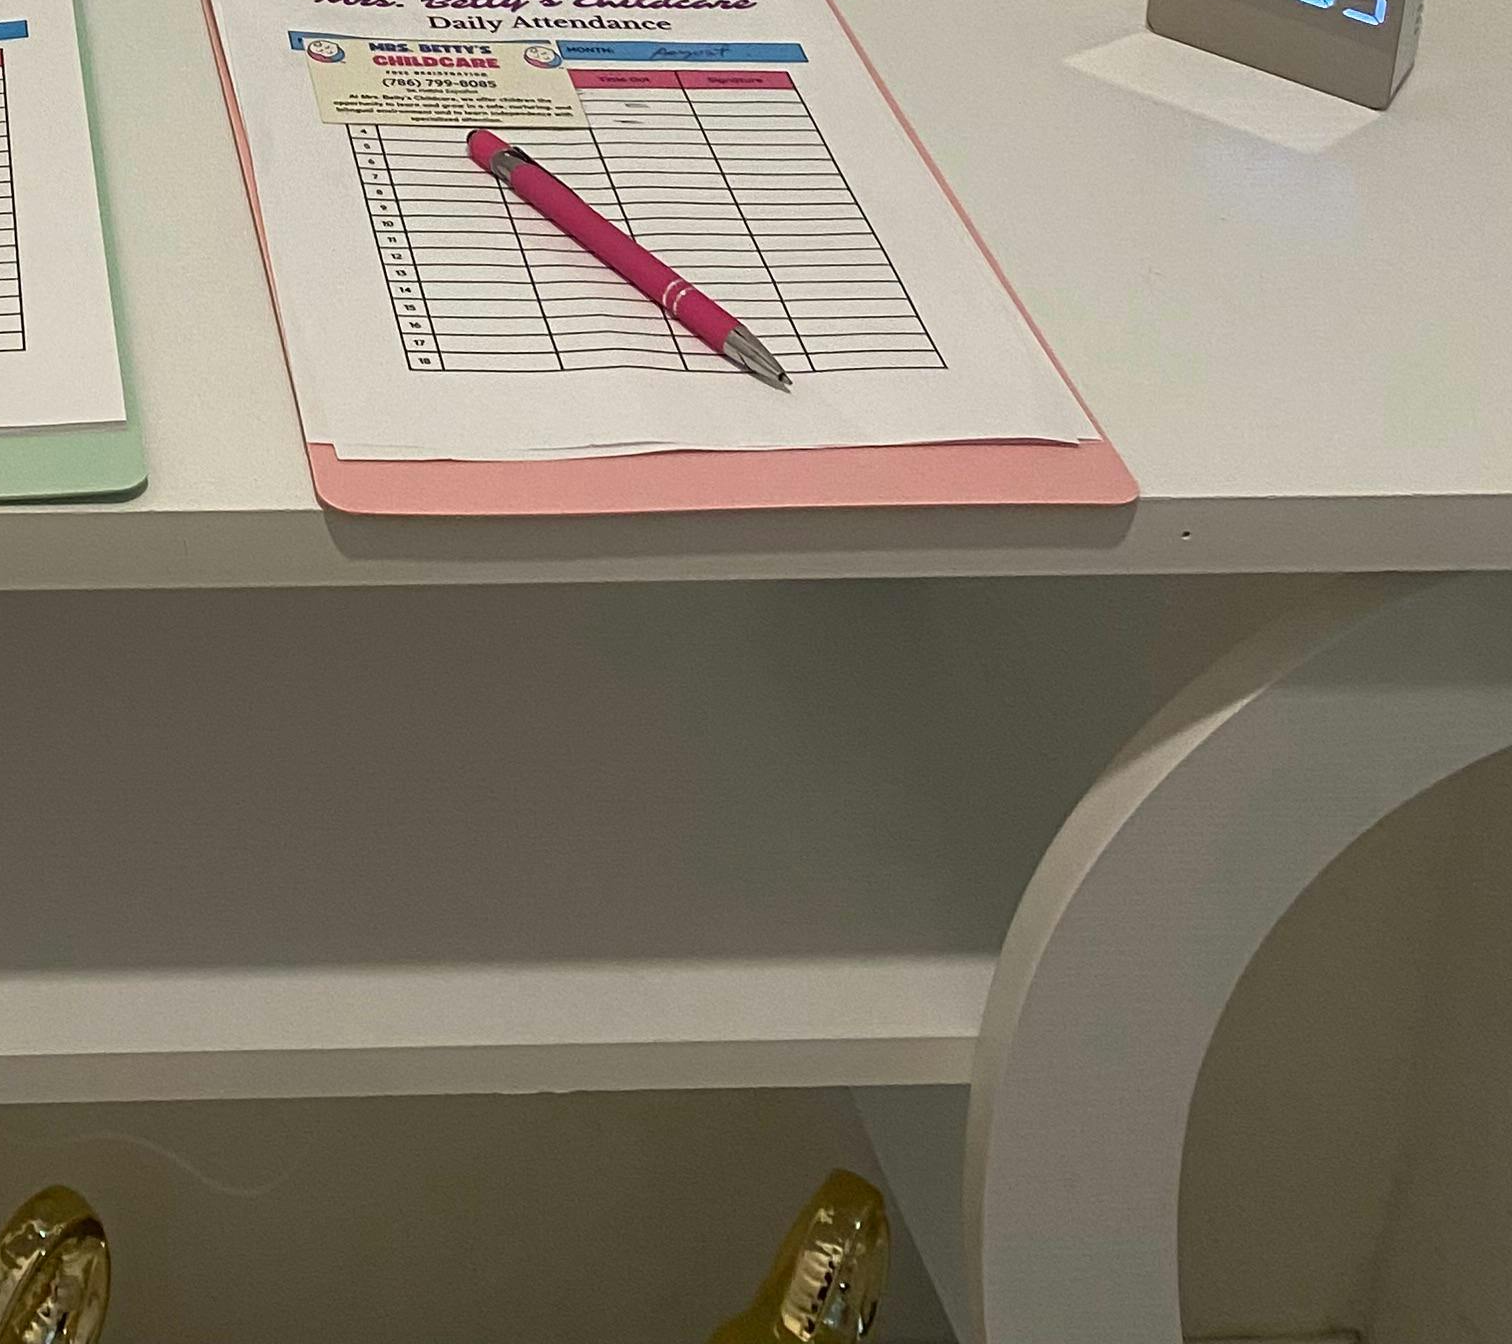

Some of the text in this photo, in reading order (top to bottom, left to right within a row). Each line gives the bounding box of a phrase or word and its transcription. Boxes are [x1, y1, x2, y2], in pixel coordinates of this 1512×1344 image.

[427, 15, 673, 33] Daily Attendance
[369, 42, 492, 55] MRS. BETTY'S
[372, 55, 500, 68] CHILDCARE
[382, 78, 497, 88] (786) 799-8085
